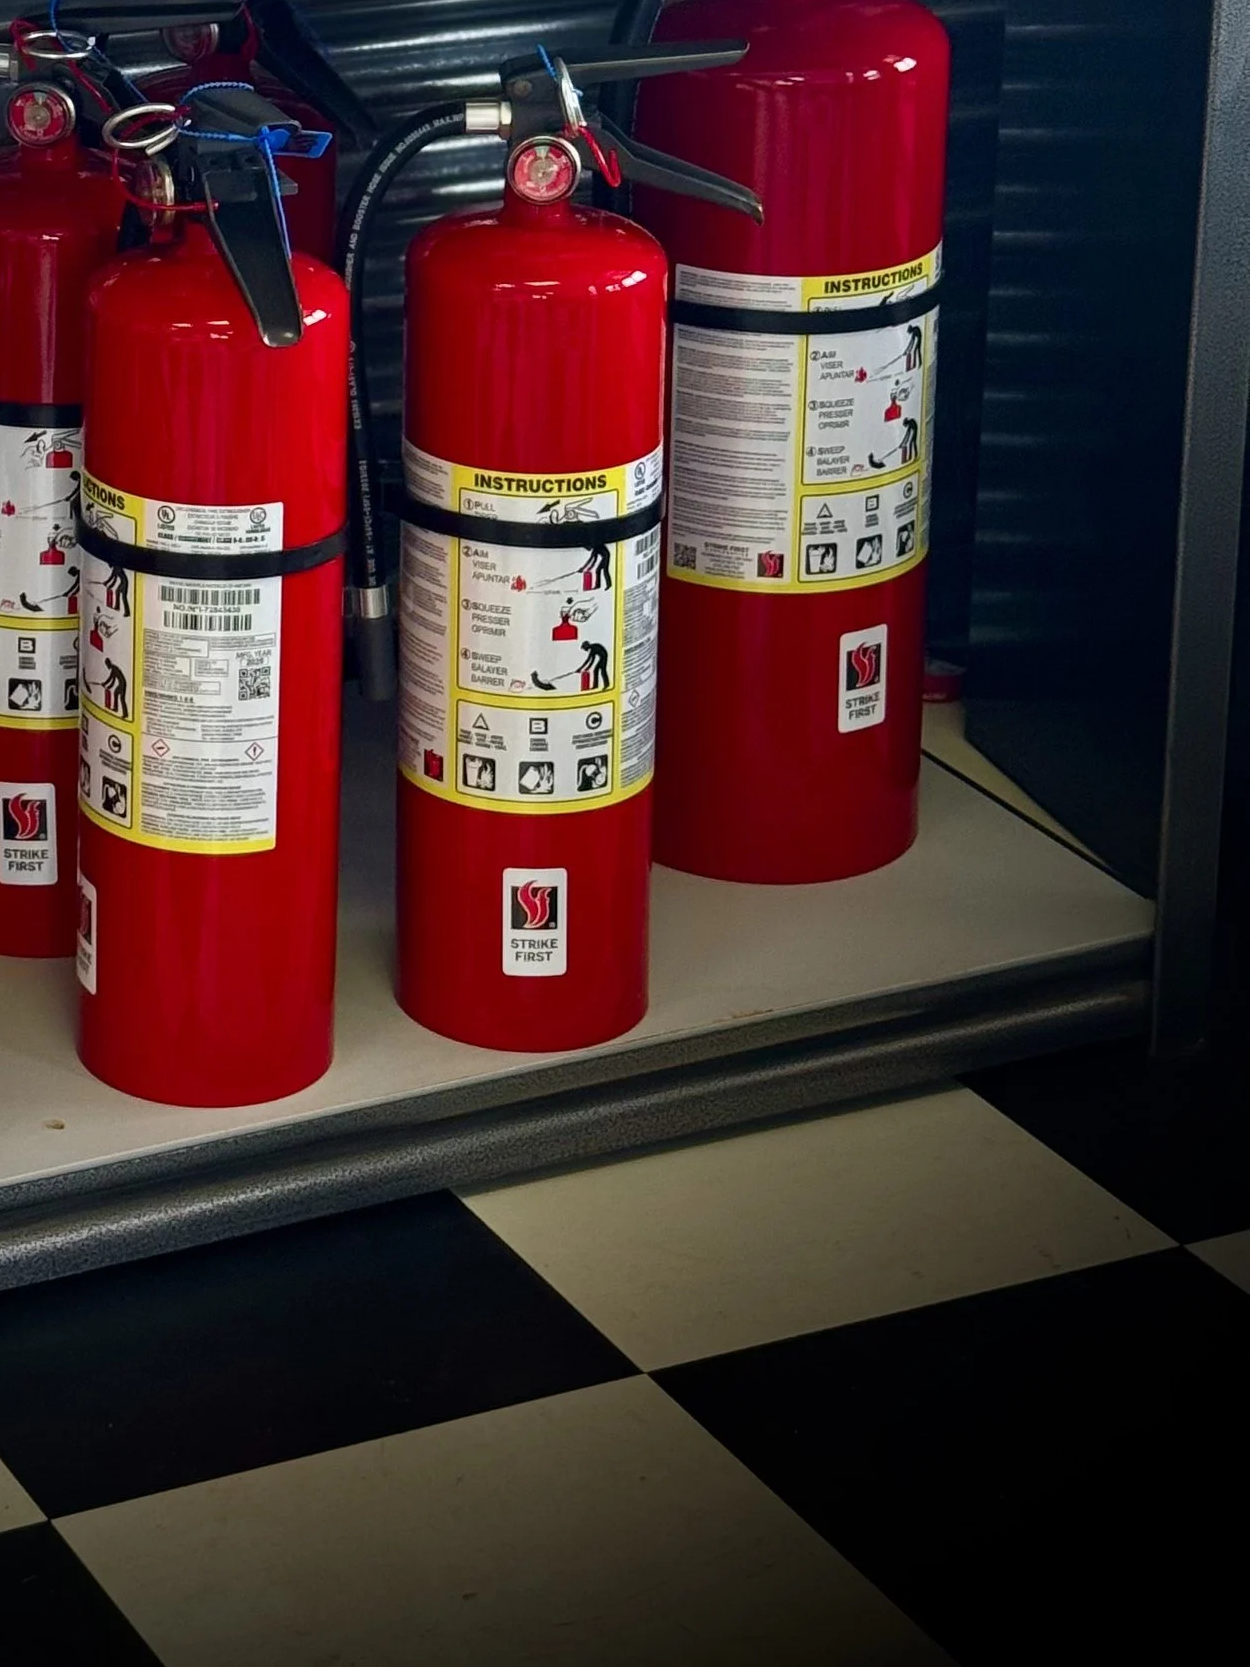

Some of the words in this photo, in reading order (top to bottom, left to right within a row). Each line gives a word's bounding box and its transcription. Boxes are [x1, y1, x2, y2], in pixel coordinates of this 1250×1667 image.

[824, 262, 923, 294] INSTRUCTIONS
[474, 474, 607, 493] INSTRUCTIONS
[474, 501, 496, 511] PULL
[473, 548, 489, 559] AIM
[472, 560, 496, 571] VISER
[472, 572, 510, 584] APUNTAR
[472, 602, 512, 615] SQUEEZE
[471, 613, 510, 626] PRESSER
[471, 651, 502, 663] SWEEP
[845, 691, 879, 709] STRIKE
[849, 704, 877, 720] FIRST
[4, 848, 49, 860] STRIKE
[8, 861, 44, 872] FIRST
[510, 938, 558, 949] STRIKE
[515, 951, 553, 962] FIRST
